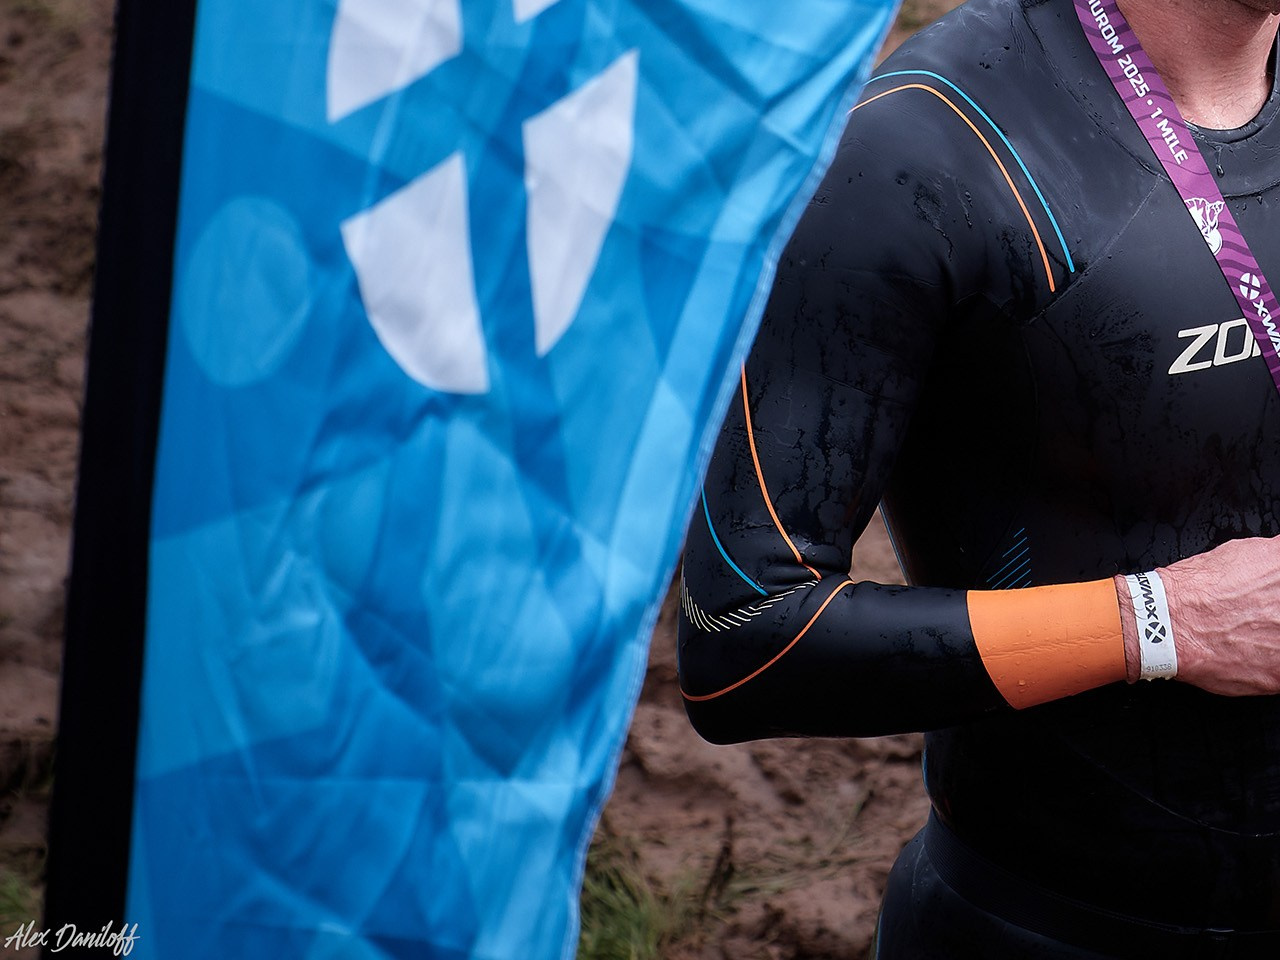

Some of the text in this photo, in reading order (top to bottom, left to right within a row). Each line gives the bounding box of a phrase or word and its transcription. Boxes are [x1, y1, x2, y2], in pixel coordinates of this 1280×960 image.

[1117, 54, 1151, 98] 2025
[1150, 107, 1163, 119] 1
[1156, 118, 1189, 165] MILE
